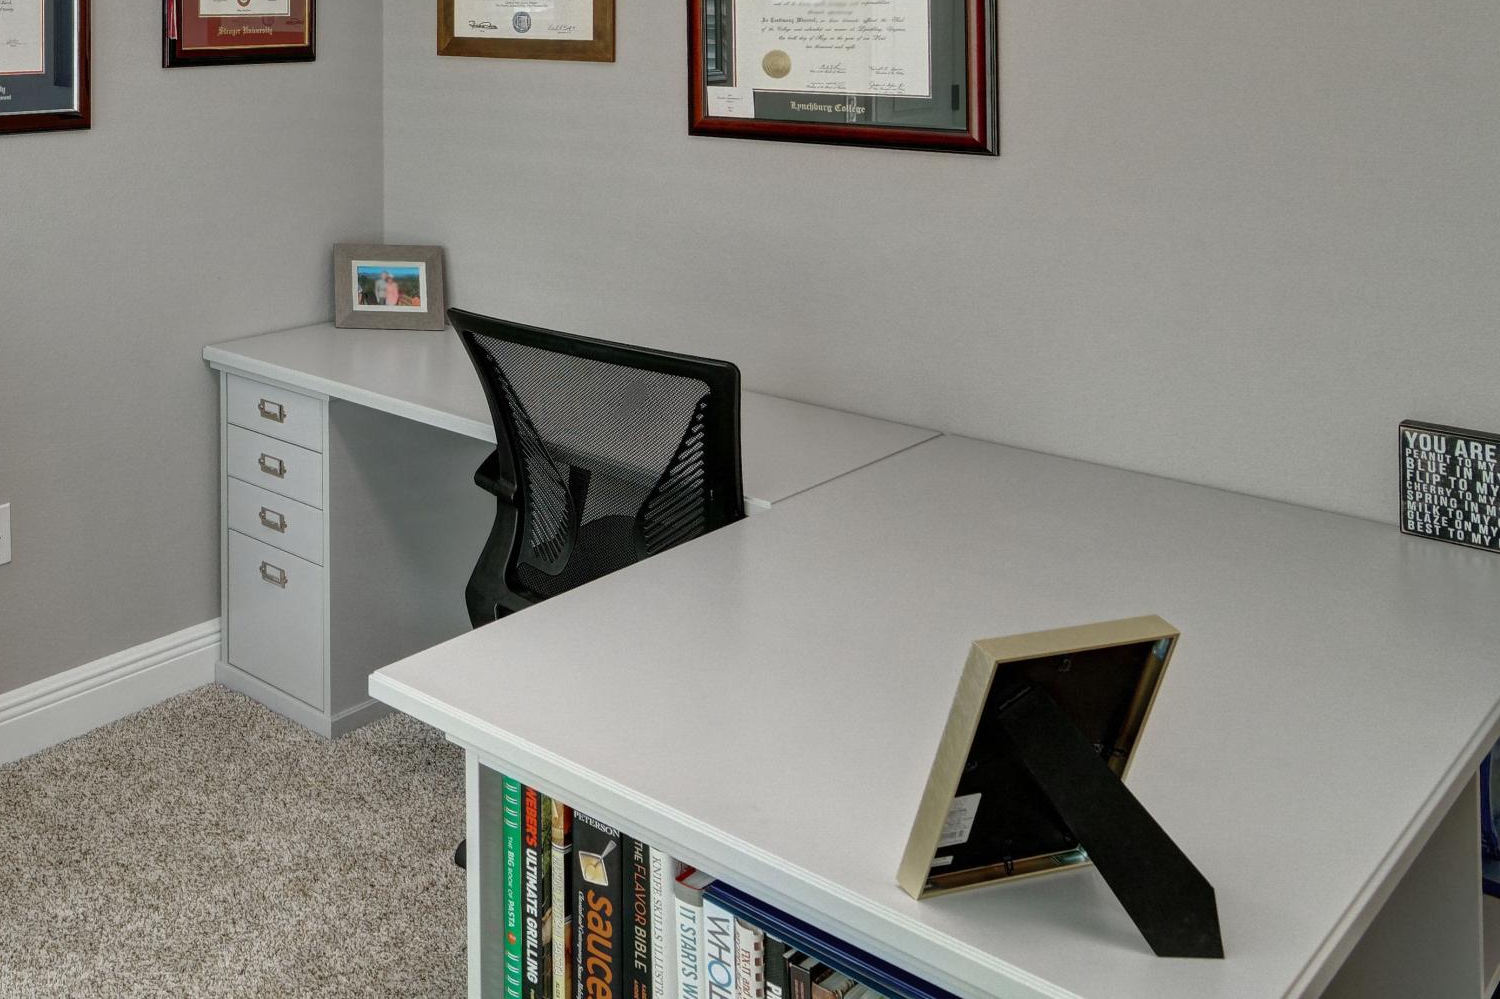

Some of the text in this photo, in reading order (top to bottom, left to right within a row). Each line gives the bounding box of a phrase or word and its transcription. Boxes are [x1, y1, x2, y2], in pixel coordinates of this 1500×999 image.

[243, 25, 273, 35] University
[790, 101, 866, 114] Lynchburg College
[1405, 431, 1498, 463] YOU ARE
[1405, 448, 1495, 472] PEANUT TO MY
[1406, 457, 1447, 475] BLUE
[1456, 466, 1473, 480] IN
[1406, 470, 1499, 496] FLIP TO MY
[1406, 481, 1496, 505] CHERRY TO MY
[1406, 490, 1500, 517] SPRING IN M
[1406, 500, 1491, 526] MILK TO MY
[1407, 510, 1499, 537] GLAZE ON MY
[1407, 520, 1492, 547] BEST TO MY
[574, 810, 620, 838] PETERSON
[634, 841, 643, 863] THE
[508, 889, 513, 899] OF
[526, 787, 538, 984] WEBER'S ULTIMATE GRILLING
[634, 863, 647, 926] FLAVOR
[652, 856, 664, 999] KNIFE SKILLS ILLUSTR
[586, 890, 613, 999] sauce
[635, 925, 647, 974] BIBLE
[680, 905, 699, 999] IT STARTS W
[741, 948, 753, 998] FIX-IT and
